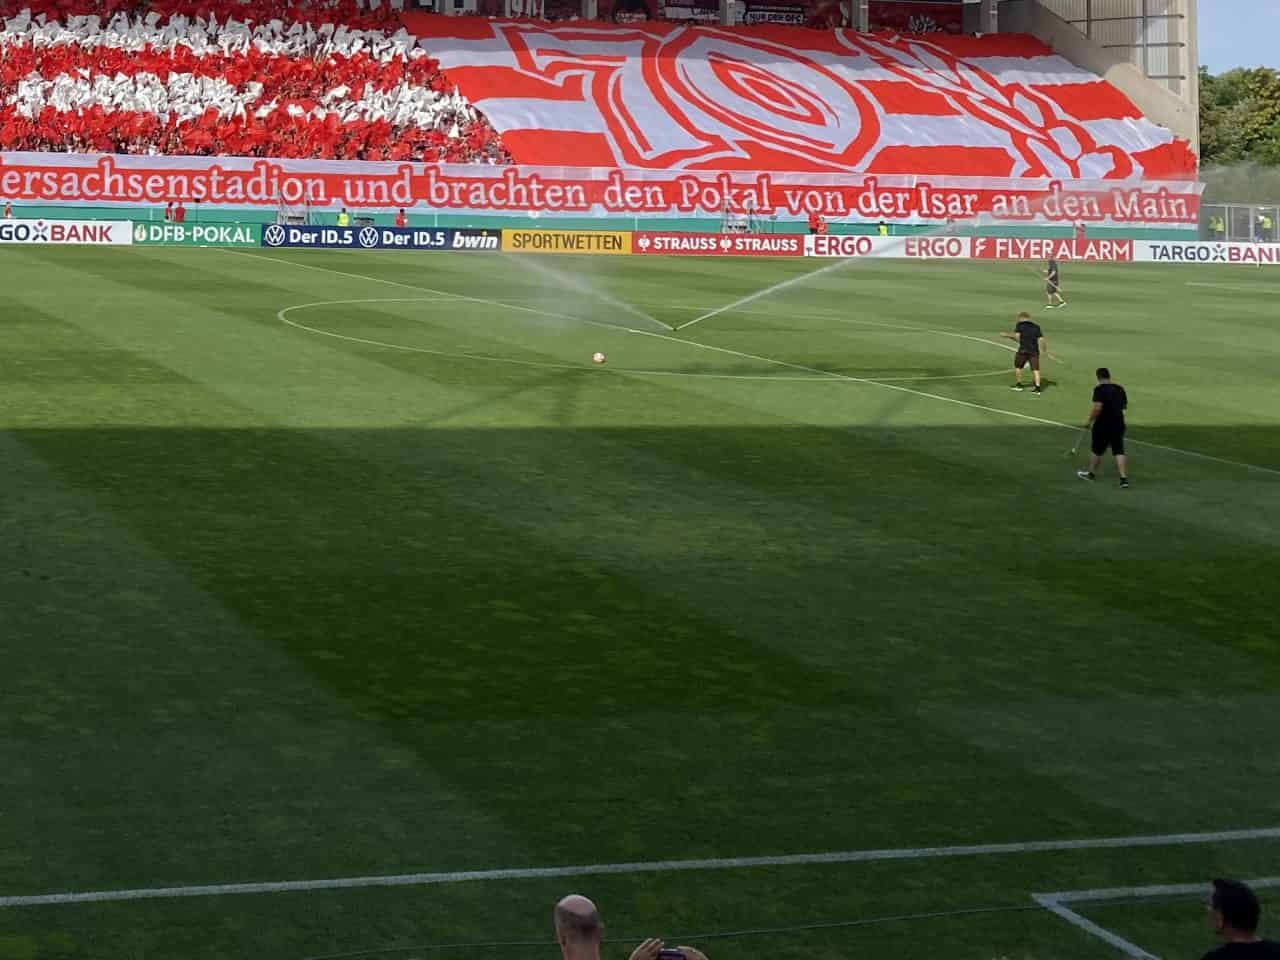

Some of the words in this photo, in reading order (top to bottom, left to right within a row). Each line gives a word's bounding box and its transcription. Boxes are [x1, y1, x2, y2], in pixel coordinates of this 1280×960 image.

[343, 167, 412, 205] und
[426, 168, 587, 209] brachten
[604, 171, 664, 209] den
[680, 175, 772, 213] Pokal
[784, 192, 846, 214] von
[858, 179, 910, 215] der
[920, 189, 979, 217] Isar
[992, 194, 1032, 218] an
[1043, 186, 1100, 218] den
[149, 224, 255, 244] DFB-POKAL
[289, 230, 318, 244] Der
[321, 230, 353, 245] ID.5
[383, 231, 410, 246] Der
[414, 231, 445, 247] ID.5
[453, 231, 498, 249] bwin
[512, 232, 623, 250] SPORTWETTEN
[653, 236, 717, 250] STRAUSS
[735, 238, 798, 252] STRAUSS
[815, 237, 872, 256] ERGO
[905, 238, 962, 257] ERGO
[996, 239, 1131, 260] FLYERALARM
